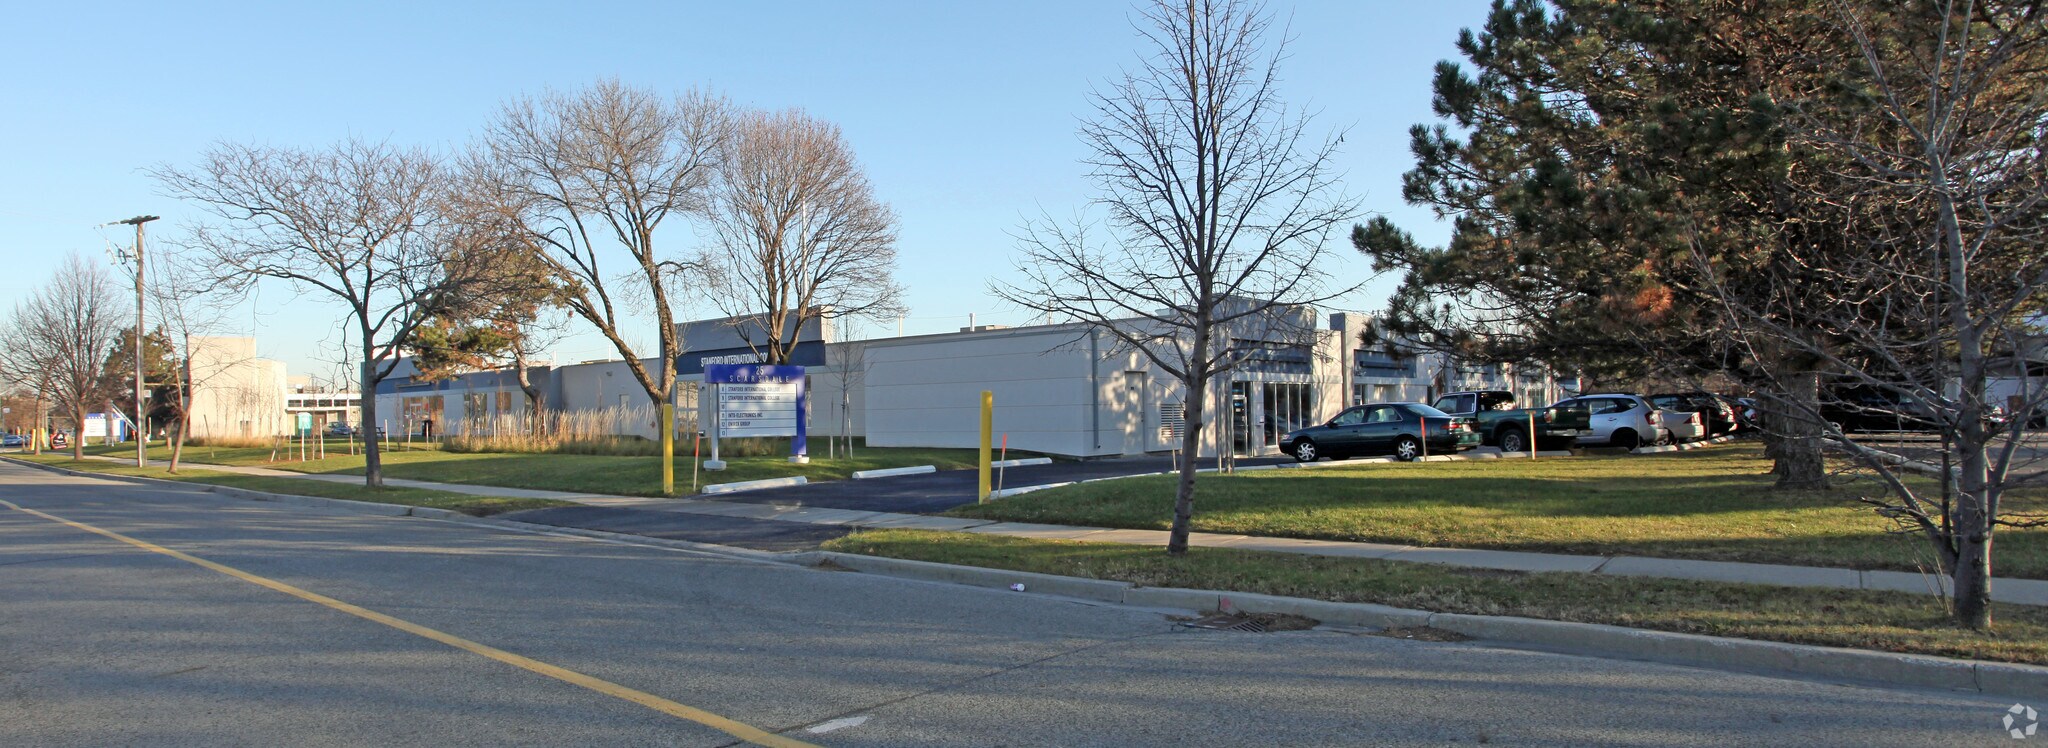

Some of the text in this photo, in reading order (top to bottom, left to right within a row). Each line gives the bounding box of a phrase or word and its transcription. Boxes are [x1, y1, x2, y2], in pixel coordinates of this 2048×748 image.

[701, 356, 723, 367] STANFORD
[724, 354, 759, 364] INTERNATIONAL
[756, 366, 765, 376] 25
